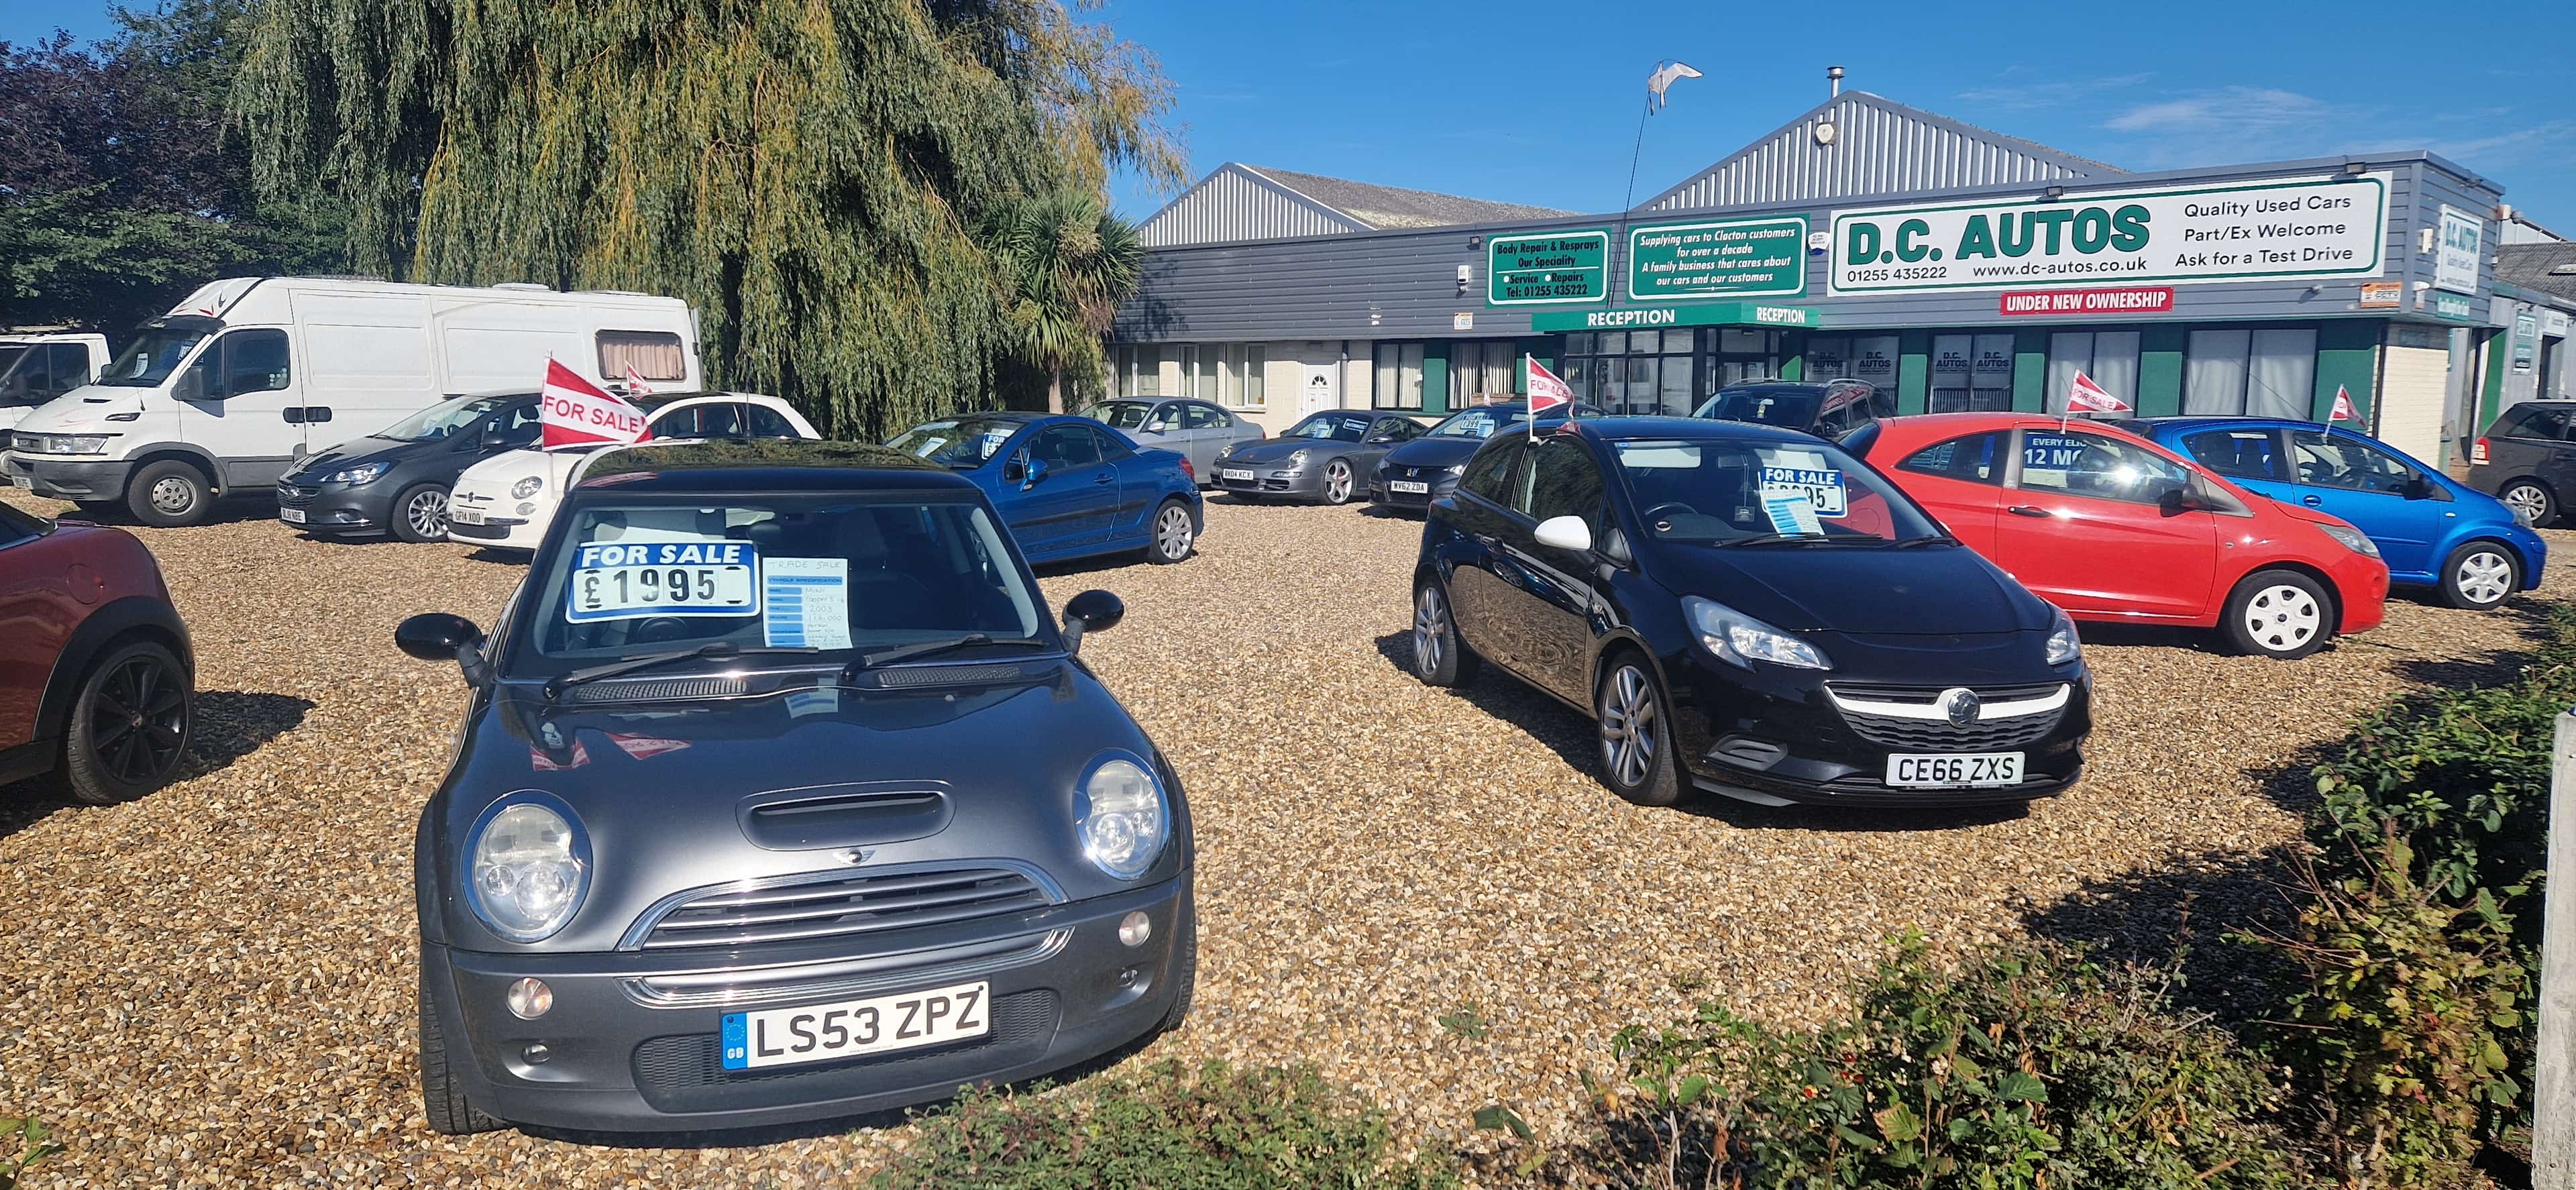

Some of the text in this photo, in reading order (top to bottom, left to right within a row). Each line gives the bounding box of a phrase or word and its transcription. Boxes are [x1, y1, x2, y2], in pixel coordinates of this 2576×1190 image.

[2184, 195, 2351, 217] Quality Used Cars
[1640, 228, 1795, 247] Supplying cars to Clacton customers
[1847, 205, 2151, 266] D.C. AUTOS
[2184, 223, 2347, 241] Part/Ex Welcome
[1497, 240, 1599, 255] Body Repair & Resprays
[1676, 247, 1690, 258] for
[1692, 248, 1711, 256] over
[1721, 243, 1753, 255] decade
[2175, 246, 2353, 266] Ask for a Test Drive
[1518, 254, 1576, 268] Our Speciality
[1642, 256, 1791, 274] A family business that cares about
[1973, 256, 2147, 277] www.dc-autos.co.uk
[1510, 272, 1584, 284] Service Repairs
[1656, 272, 1773, 285] our cars and our customers
[1847, 266, 1947, 282] 01255 435222
[1506, 284, 1587, 297] Tel: 01255 435222
[2006, 291, 2167, 311] UNDER NEW OWNERSHIP
[1587, 309, 1675, 327] RECEPTION
[1757, 307, 1806, 323] RECEPTION
[1813, 360, 1843, 368] AUTOS
[2090, 396, 2114, 410] SALE
[543, 395, 639, 433] FOR SALE
[2033, 438, 2063, 446] EVERY
[2025, 448, 2047, 465] 12
[1765, 468, 1835, 485] FOR SALE
[582, 545, 741, 567] FOR SALE
[767, 561, 842, 570] TRADE SALE
[1898, 757, 2015, 782] CE66 ZXS
[757, 991, 980, 1057] LS53 ZPZ
[727, 1048, 745, 1060] GB
